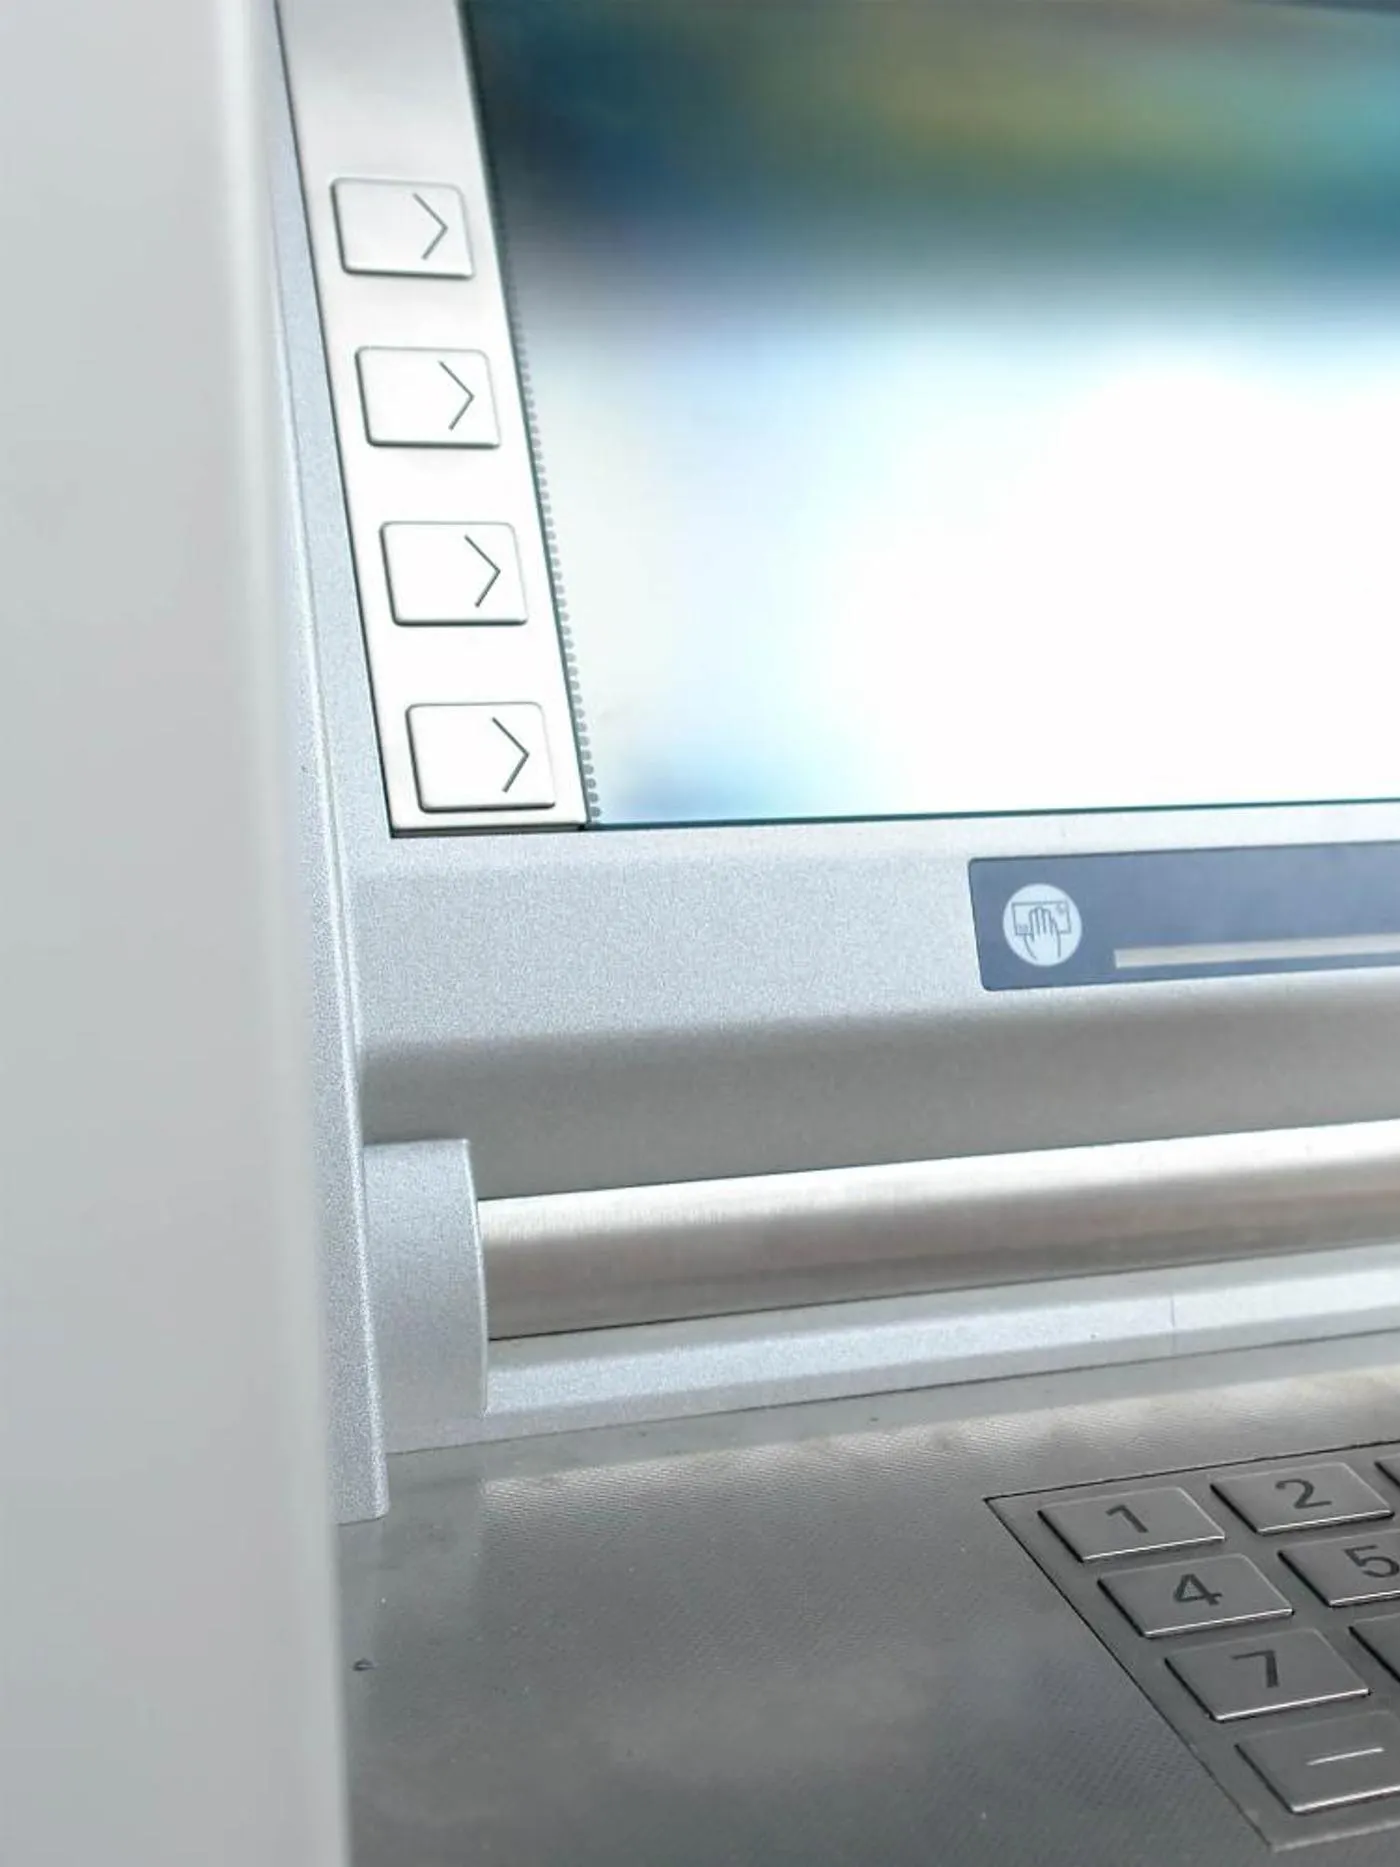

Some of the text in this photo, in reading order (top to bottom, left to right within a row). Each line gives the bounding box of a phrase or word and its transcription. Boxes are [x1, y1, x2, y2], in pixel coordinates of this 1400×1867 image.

[1275, 1478, 1332, 1510] 2
[1105, 1504, 1149, 1534] 1
[1343, 1544, 1400, 1579] 5
[1172, 1572, 1223, 1606] 4
[1230, 1648, 1280, 1689] 7
